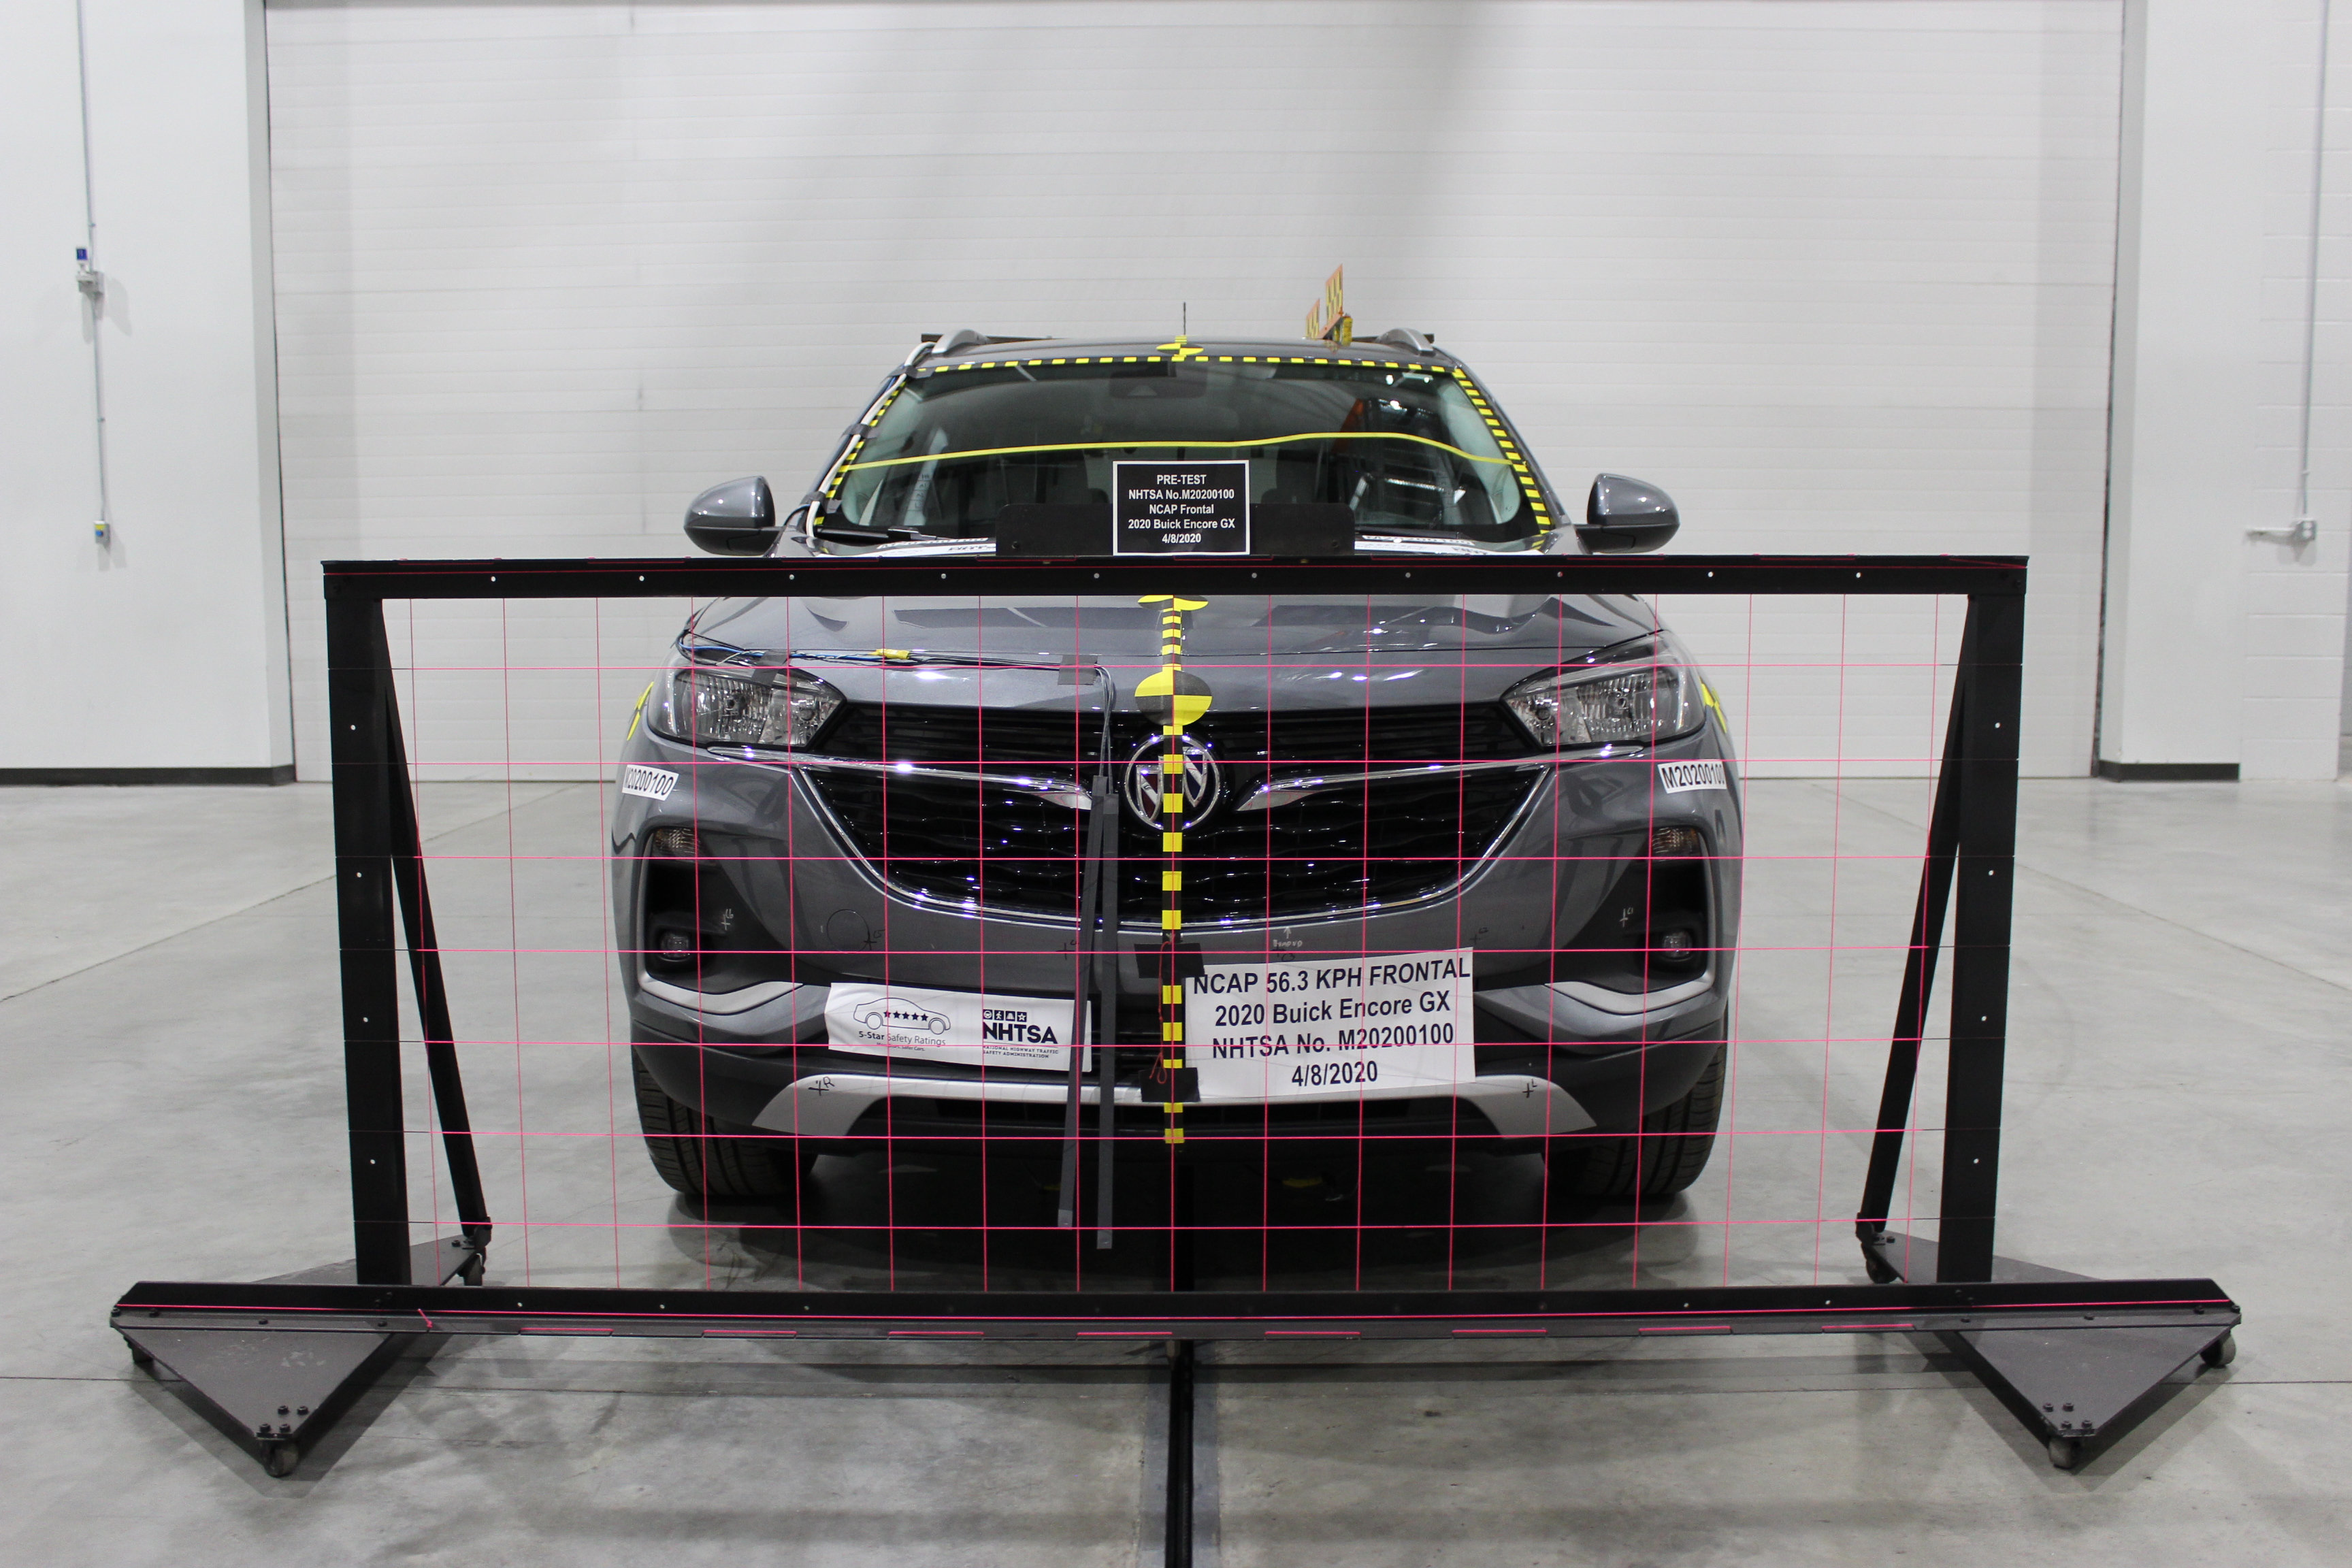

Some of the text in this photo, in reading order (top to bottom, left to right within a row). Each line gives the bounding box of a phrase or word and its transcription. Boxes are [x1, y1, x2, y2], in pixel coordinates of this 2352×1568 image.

[1156, 474, 1207, 485] PRE-TEST
[1128, 489, 1235, 500] NHTSA No.M20200100
[1149, 504, 1215, 514] NCAP Frontal
[1128, 518, 1236, 529] 2020 Buick Encore GX
[1162, 533, 1202, 544] 4/8/2020
[1194, 958, 1471, 994] NCAP 56.3 KPH FRONTAL
[1215, 990, 1451, 1026] 2020 Buick Encore GX
[858, 1031, 885, 1040] 5-Star
[887, 1033, 913, 1045] Safety
[914, 1035, 946, 1047] Ratings
[982, 1022, 1058, 1045] NHTSA
[1213, 1022, 1454, 1059] NHTSA No. M20200100
[1292, 1060, 1378, 1087] 4/8/2020
